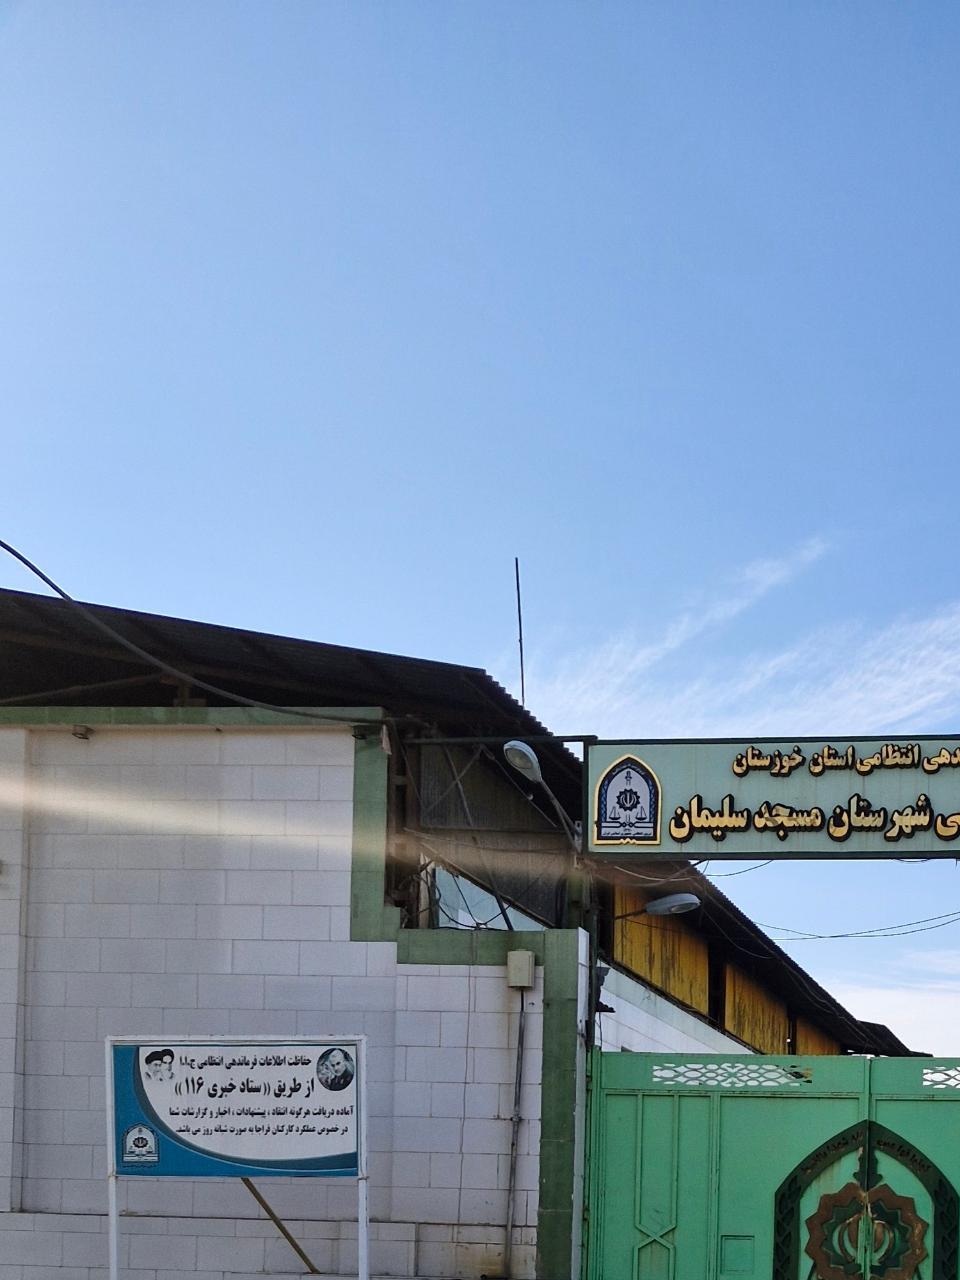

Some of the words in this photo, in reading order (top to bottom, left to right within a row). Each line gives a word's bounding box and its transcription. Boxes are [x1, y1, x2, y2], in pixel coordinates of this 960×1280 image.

[732, 745, 805, 777] خوزستان
[809, 745, 853, 775] استان
[857, 744, 920, 774] انتظامی
[669, 794, 749, 843] سلیمان
[753, 800, 822, 841] مسجد
[828, 793, 931, 842] شهرستان
[198, 1056, 223, 1069] انتظامی
[226, 1056, 257, 1069] فرماندهی
[259, 1056, 286, 1066] اطلاعات
[288, 1056, 311, 1066] حفاظت
[208, 1078, 236, 1098] خبری
[274, 1077, 302, 1097] طریق
[304, 1077, 314, 1098] از
[169, 1107, 180, 1116] شما
[209, 1110, 213, 1118] و
[215, 1107, 230, 1118] اخبار
[236, 1107, 266, 1119] پیشنهادات
[272, 1107, 288, 1116] انتقاد
[312, 1106, 335, 1118] دریافت
[336, 1105, 354, 1116] آماده
[203, 1127, 212, 1135] روز
[317, 1125, 339, 1135] خصوص
[341, 1125, 348, 1135] در
